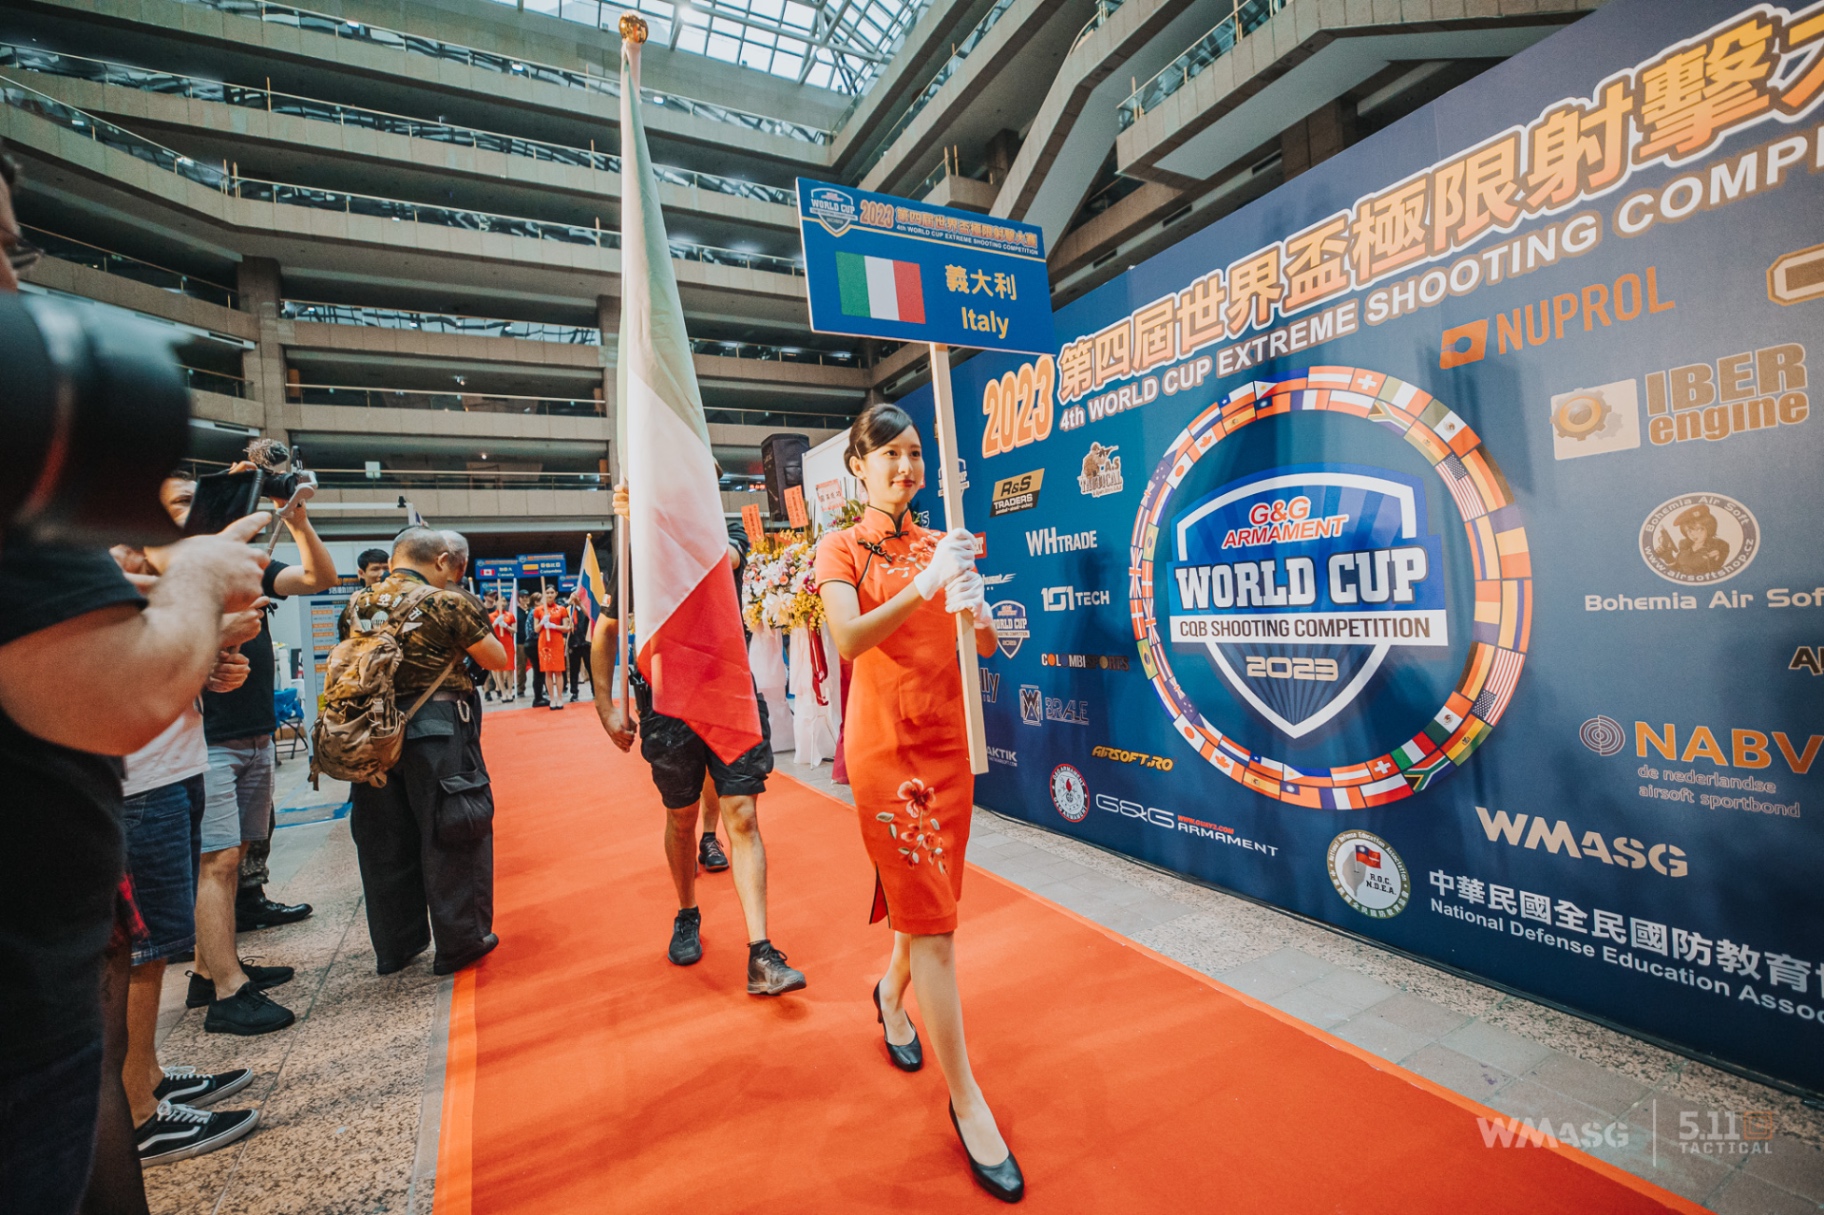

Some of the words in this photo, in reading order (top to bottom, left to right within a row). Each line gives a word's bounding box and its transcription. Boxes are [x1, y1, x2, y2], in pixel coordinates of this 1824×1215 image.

[859, 199, 894, 229] 2023
[908, 226, 930, 236] WORLD
[931, 230, 943, 238] CUP
[945, 232, 972, 244] EXTREME
[973, 238, 1002, 249] SHOOTING
[1002, 243, 1039, 256] COMPETITION
[945, 264, 1017, 301] 義大利
[961, 307, 1009, 339] Italy
[1060, 409, 1085, 430] 4th
[1088, 379, 1158, 421] WORLD
[1164, 359, 1211, 394] CUP
[1218, 303, 1356, 375] EXTREME
[1366, 215, 1598, 323] SHOOTING
[1496, 266, 1676, 356] NUPROL
[1645, 343, 1808, 417] IBER
[982, 354, 1056, 459] 2023
[1649, 392, 1810, 445] engine
[994, 493, 1033, 510] TRADERS
[1001, 475, 1032, 497] R&S
[1250, 496, 1312, 525] G&G
[1646, 497, 1693, 533] Bohemia
[1698, 496, 1720, 505] Air
[1724, 502, 1750, 526] Soft
[1222, 514, 1349, 549] ARMAMENT
[1644, 538, 1754, 582] www.airsoftshop.cz
[1174, 555, 1317, 610] WORLD
[1328, 546, 1428, 605] CUP
[1585, 591, 1698, 611] Bohemia
[1708, 590, 1754, 610] Air
[1179, 621, 1208, 638] CQB
[1211, 619, 1290, 637] SHOOTING
[1295, 617, 1431, 638] COMPETITION
[1246, 656, 1339, 682] 2023
[1634, 720, 1824, 775] NABV
[1637, 764, 1659, 779] de
[1663, 769, 1777, 794] nederlandse
[1096, 793, 1175, 829] G&G
[1638, 784, 1695, 803] airsoft
[1700, 793, 1800, 818] sportbond
[1177, 822, 1279, 857] ARMAMENT
[1475, 806, 1688, 878] WMASG
[1431, 898, 1504, 932] National
[1510, 920, 1596, 958] Defense
[1602, 946, 1731, 997] Education
